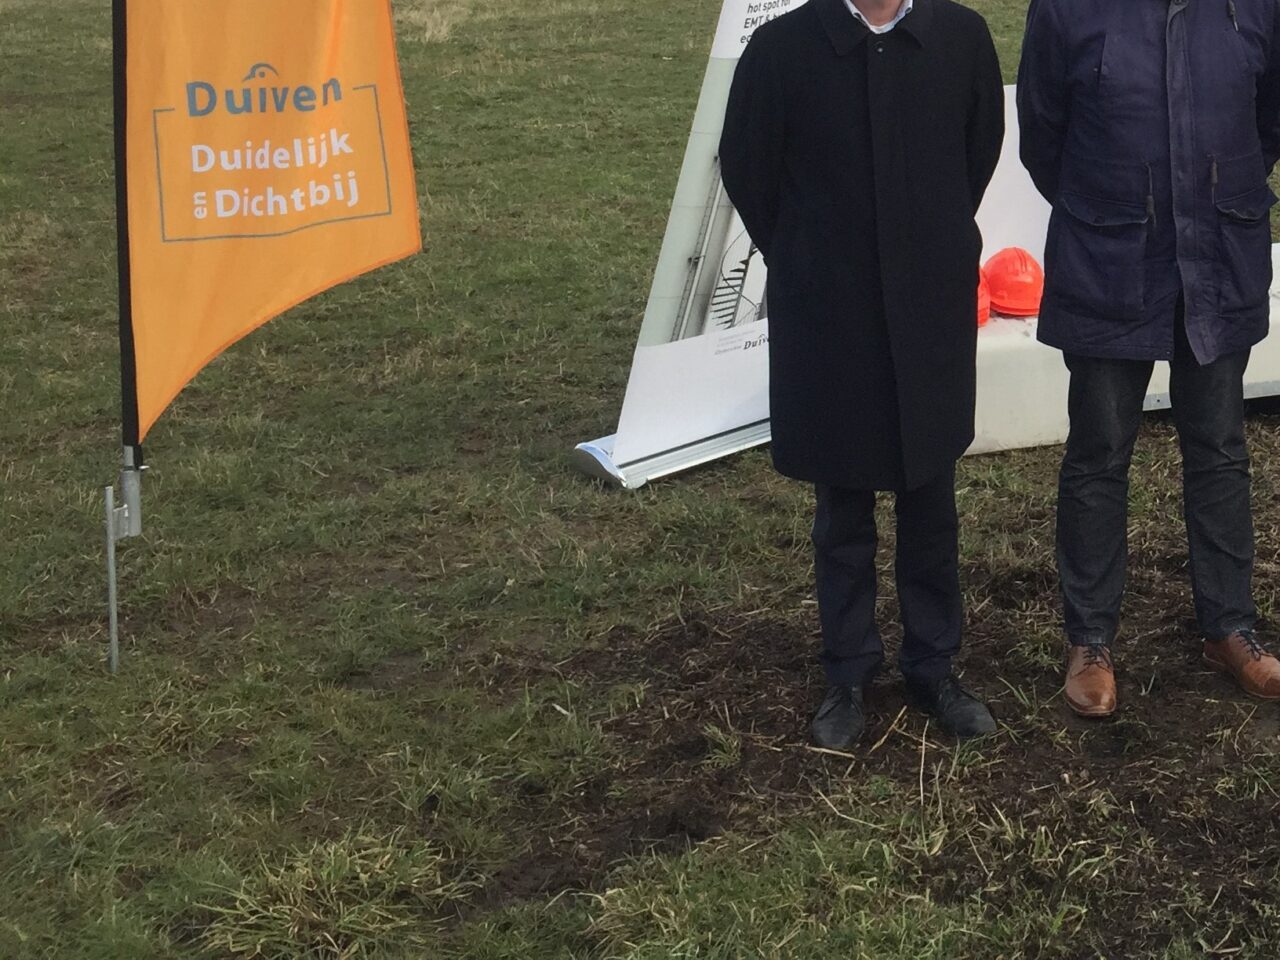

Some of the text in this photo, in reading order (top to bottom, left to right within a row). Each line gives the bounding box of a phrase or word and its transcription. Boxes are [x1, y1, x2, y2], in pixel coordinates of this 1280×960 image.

[747, 2, 761, 14] hot
[185, 76, 343, 118] Duiven
[191, 127, 353, 173] Duidelijk
[193, 170, 360, 220] en Dichtbij
